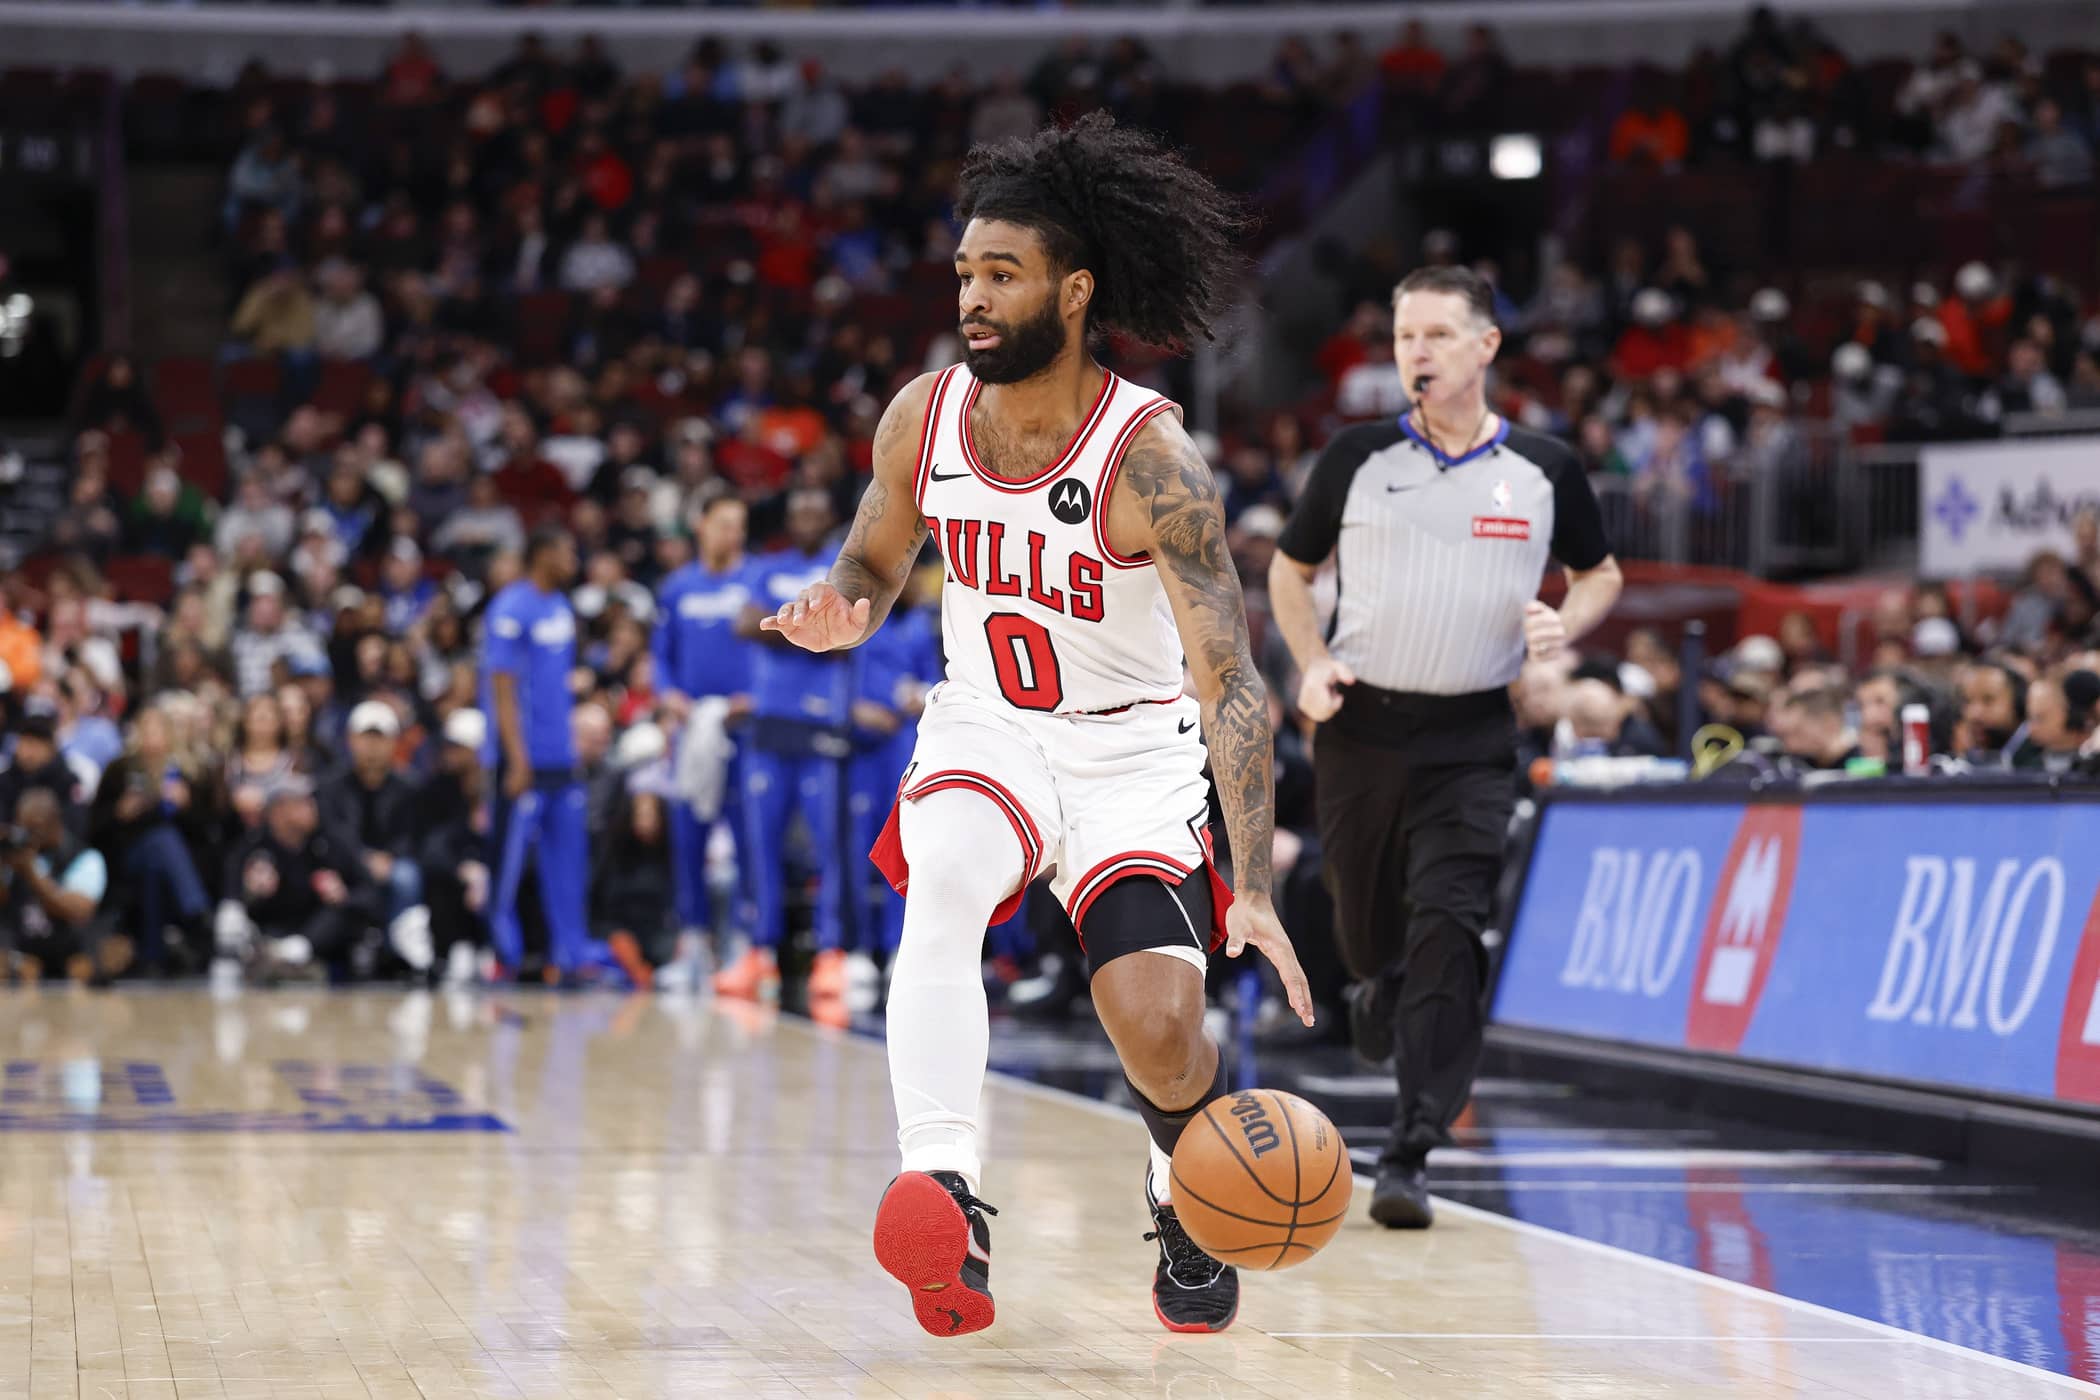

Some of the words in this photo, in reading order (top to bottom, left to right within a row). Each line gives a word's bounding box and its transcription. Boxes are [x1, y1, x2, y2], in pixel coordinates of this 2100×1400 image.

[984, 612, 1064, 713] 0
[1560, 848, 1703, 997] BMO
[1865, 854, 2066, 1036] BMO
